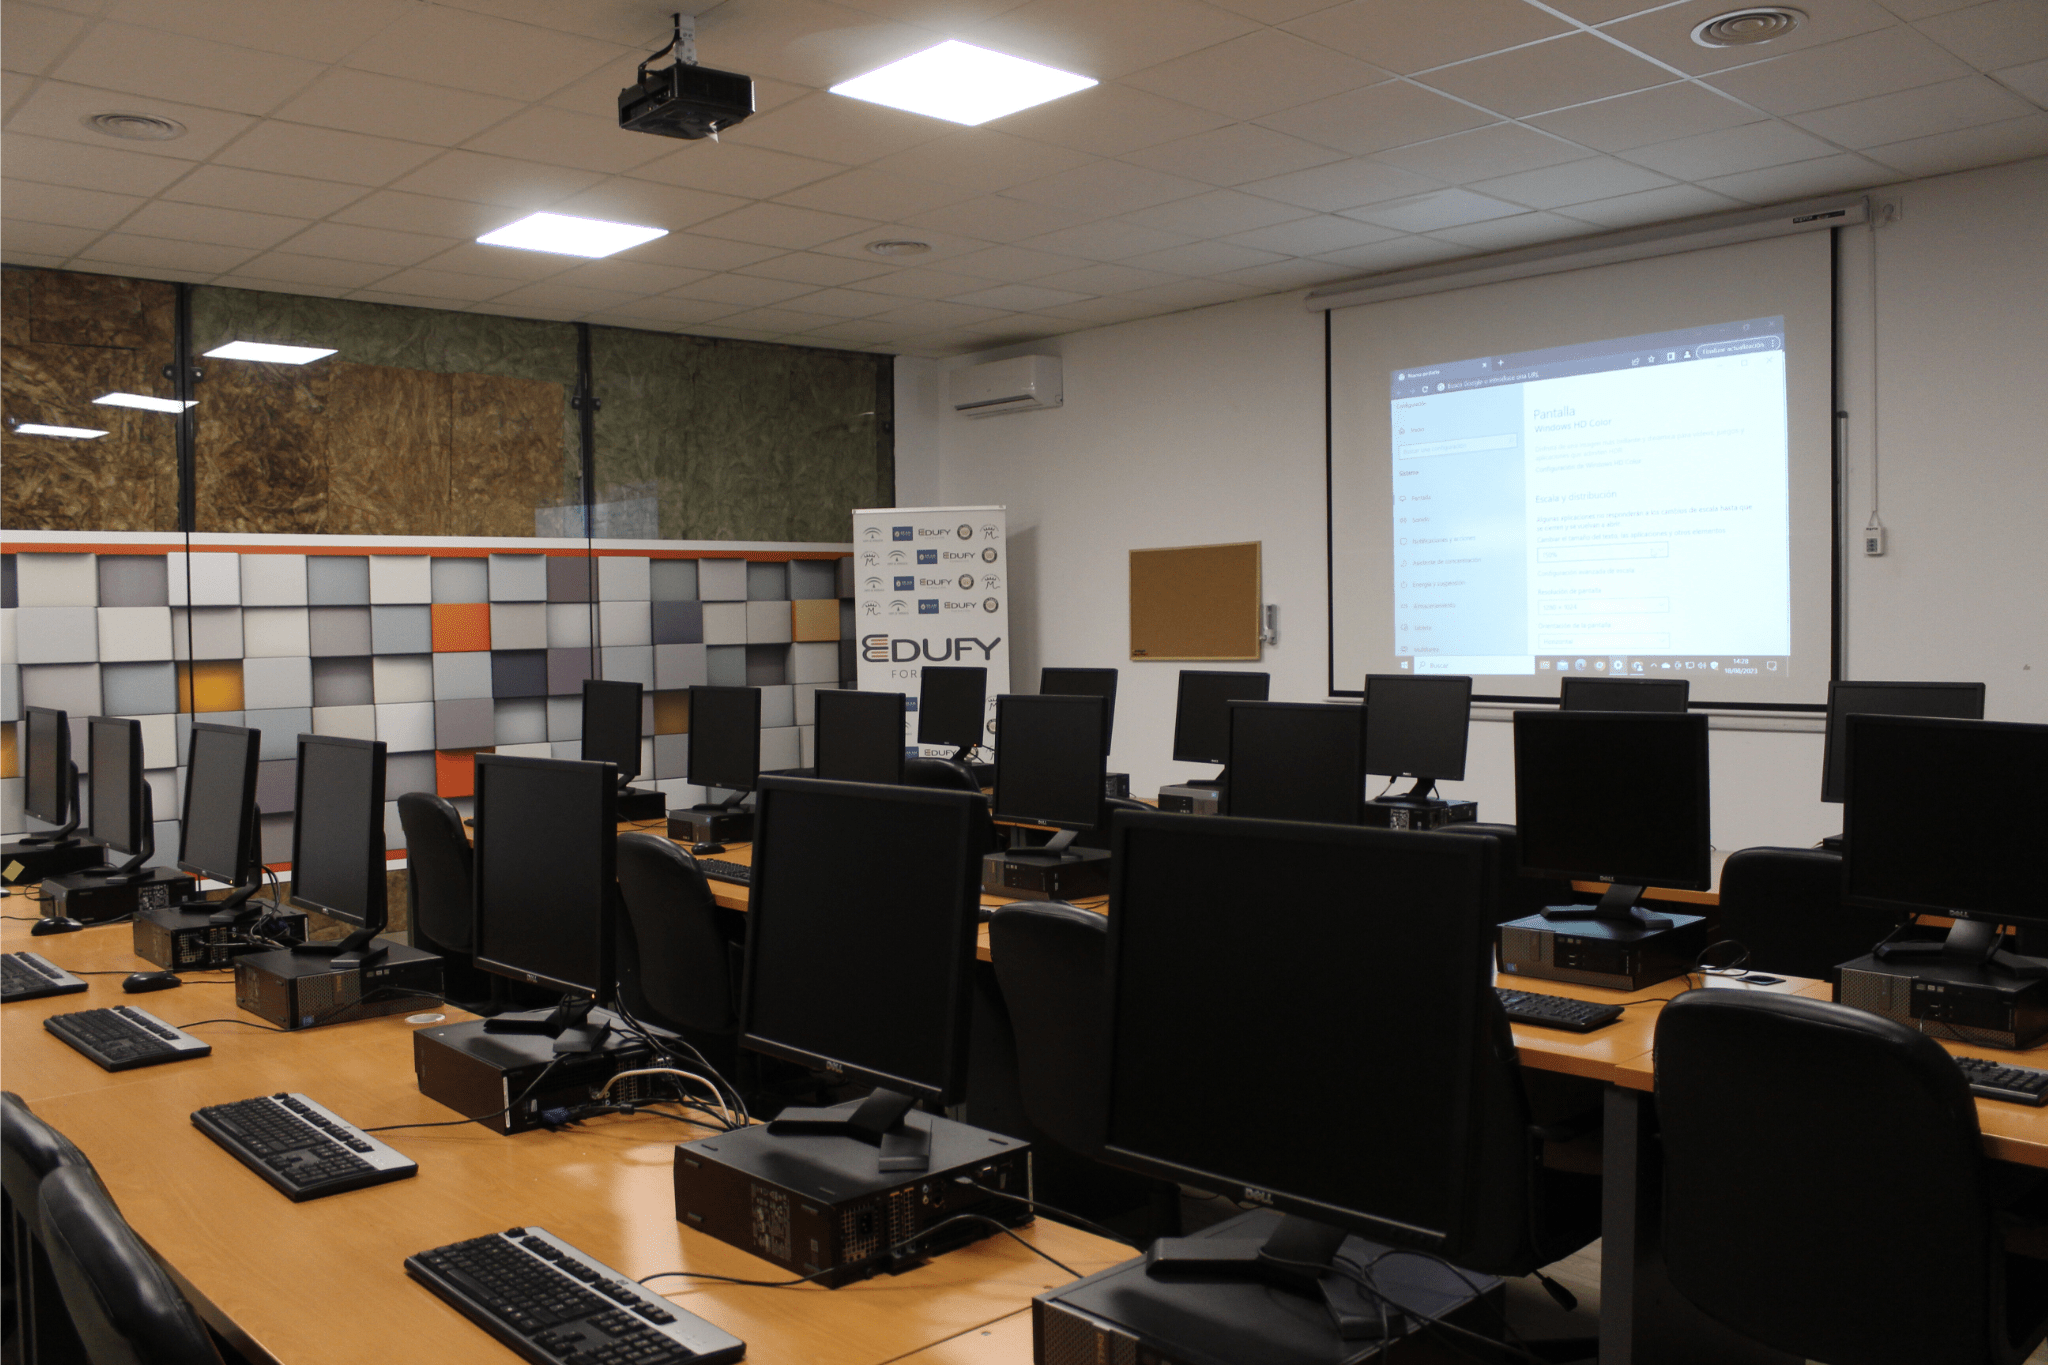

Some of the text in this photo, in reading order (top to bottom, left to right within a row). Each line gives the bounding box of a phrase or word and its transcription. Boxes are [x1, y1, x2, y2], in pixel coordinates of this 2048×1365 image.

[1533, 405, 1576, 420] Pantalla
[1534, 418, 1612, 433] Windows HD Color
[1535, 490, 1617, 504] Escala y distribución
[918, 528, 951, 537] EDUFY
[943, 551, 976, 560] EDUFY
[919, 578, 953, 587] EDUFY
[944, 601, 977, 610] EDUFY
[861, 633, 1002, 663] EDUFY
[924, 748, 957, 757] EDUFY
[1245, 1187, 1274, 1205] DELL
